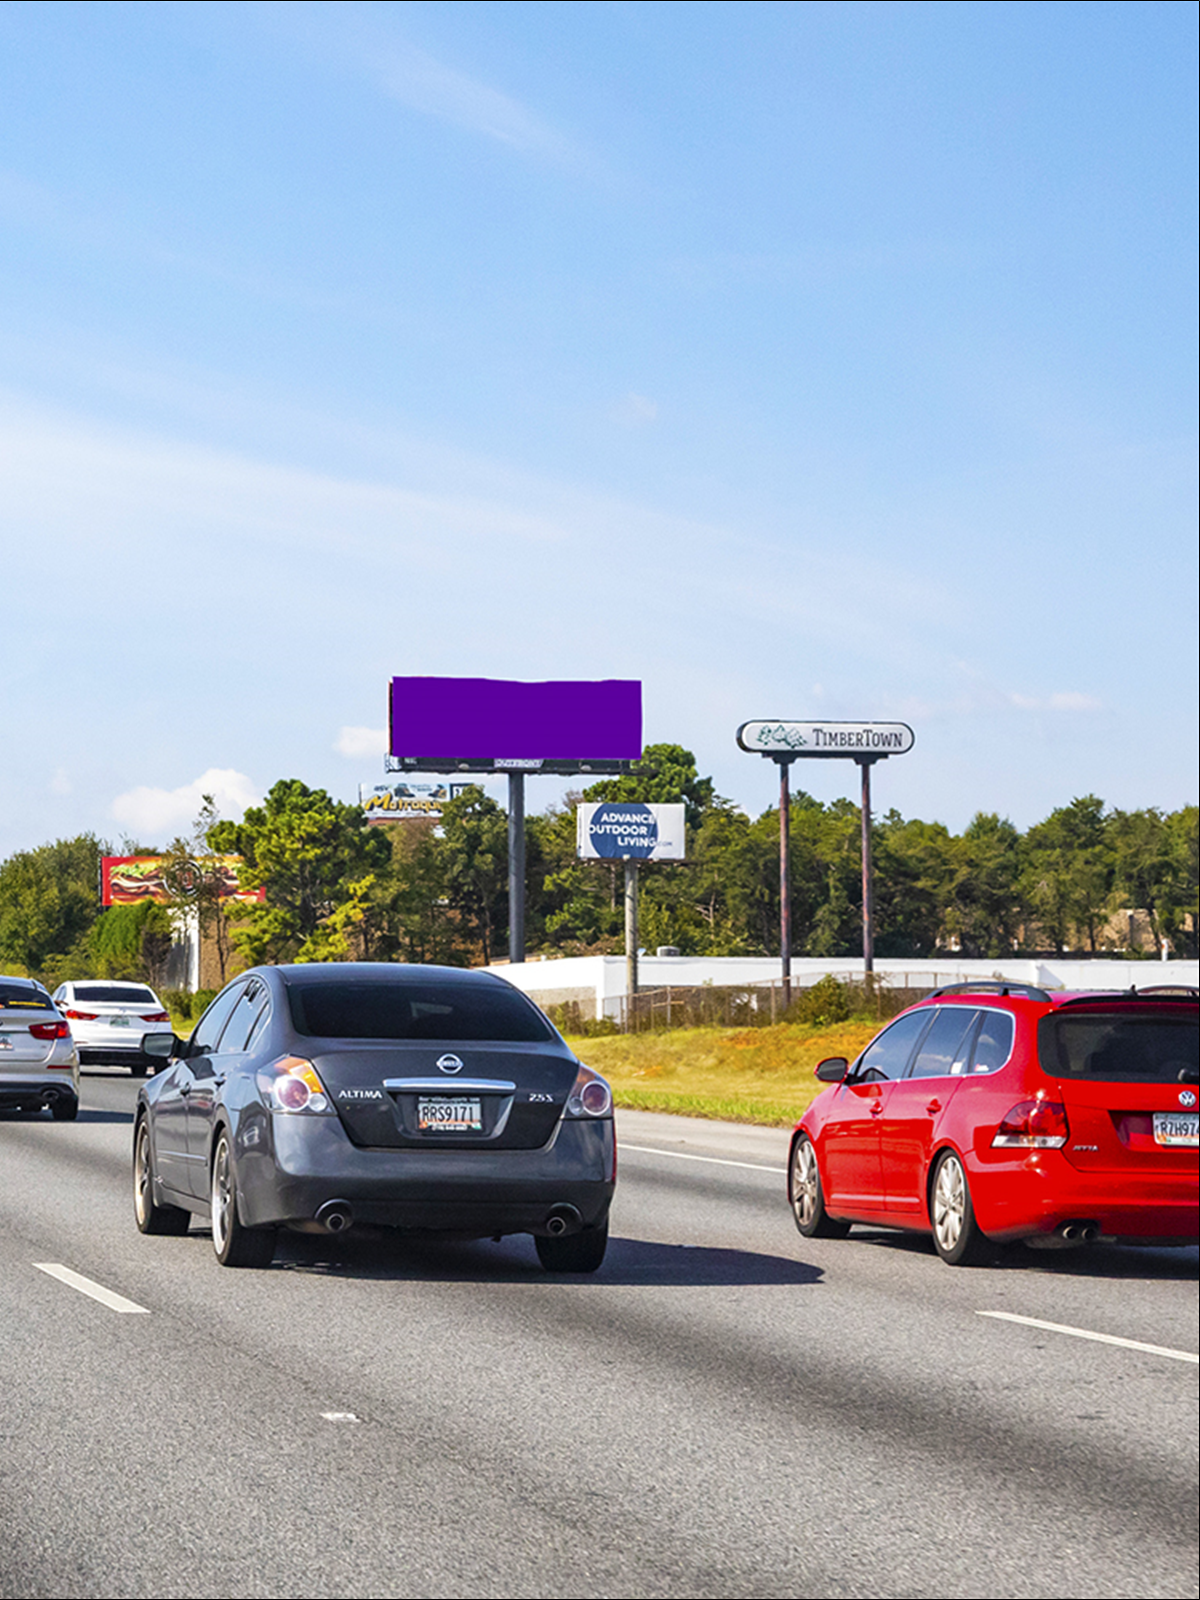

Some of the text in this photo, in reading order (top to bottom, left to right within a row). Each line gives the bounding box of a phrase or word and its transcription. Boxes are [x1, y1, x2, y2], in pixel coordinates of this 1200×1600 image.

[812, 728, 903, 747] TimberTown
[588, 824, 648, 835] OUTDOOR
[338, 1090, 383, 1099] ALTIMA
[422, 1105, 473, 1122] RRS9171
